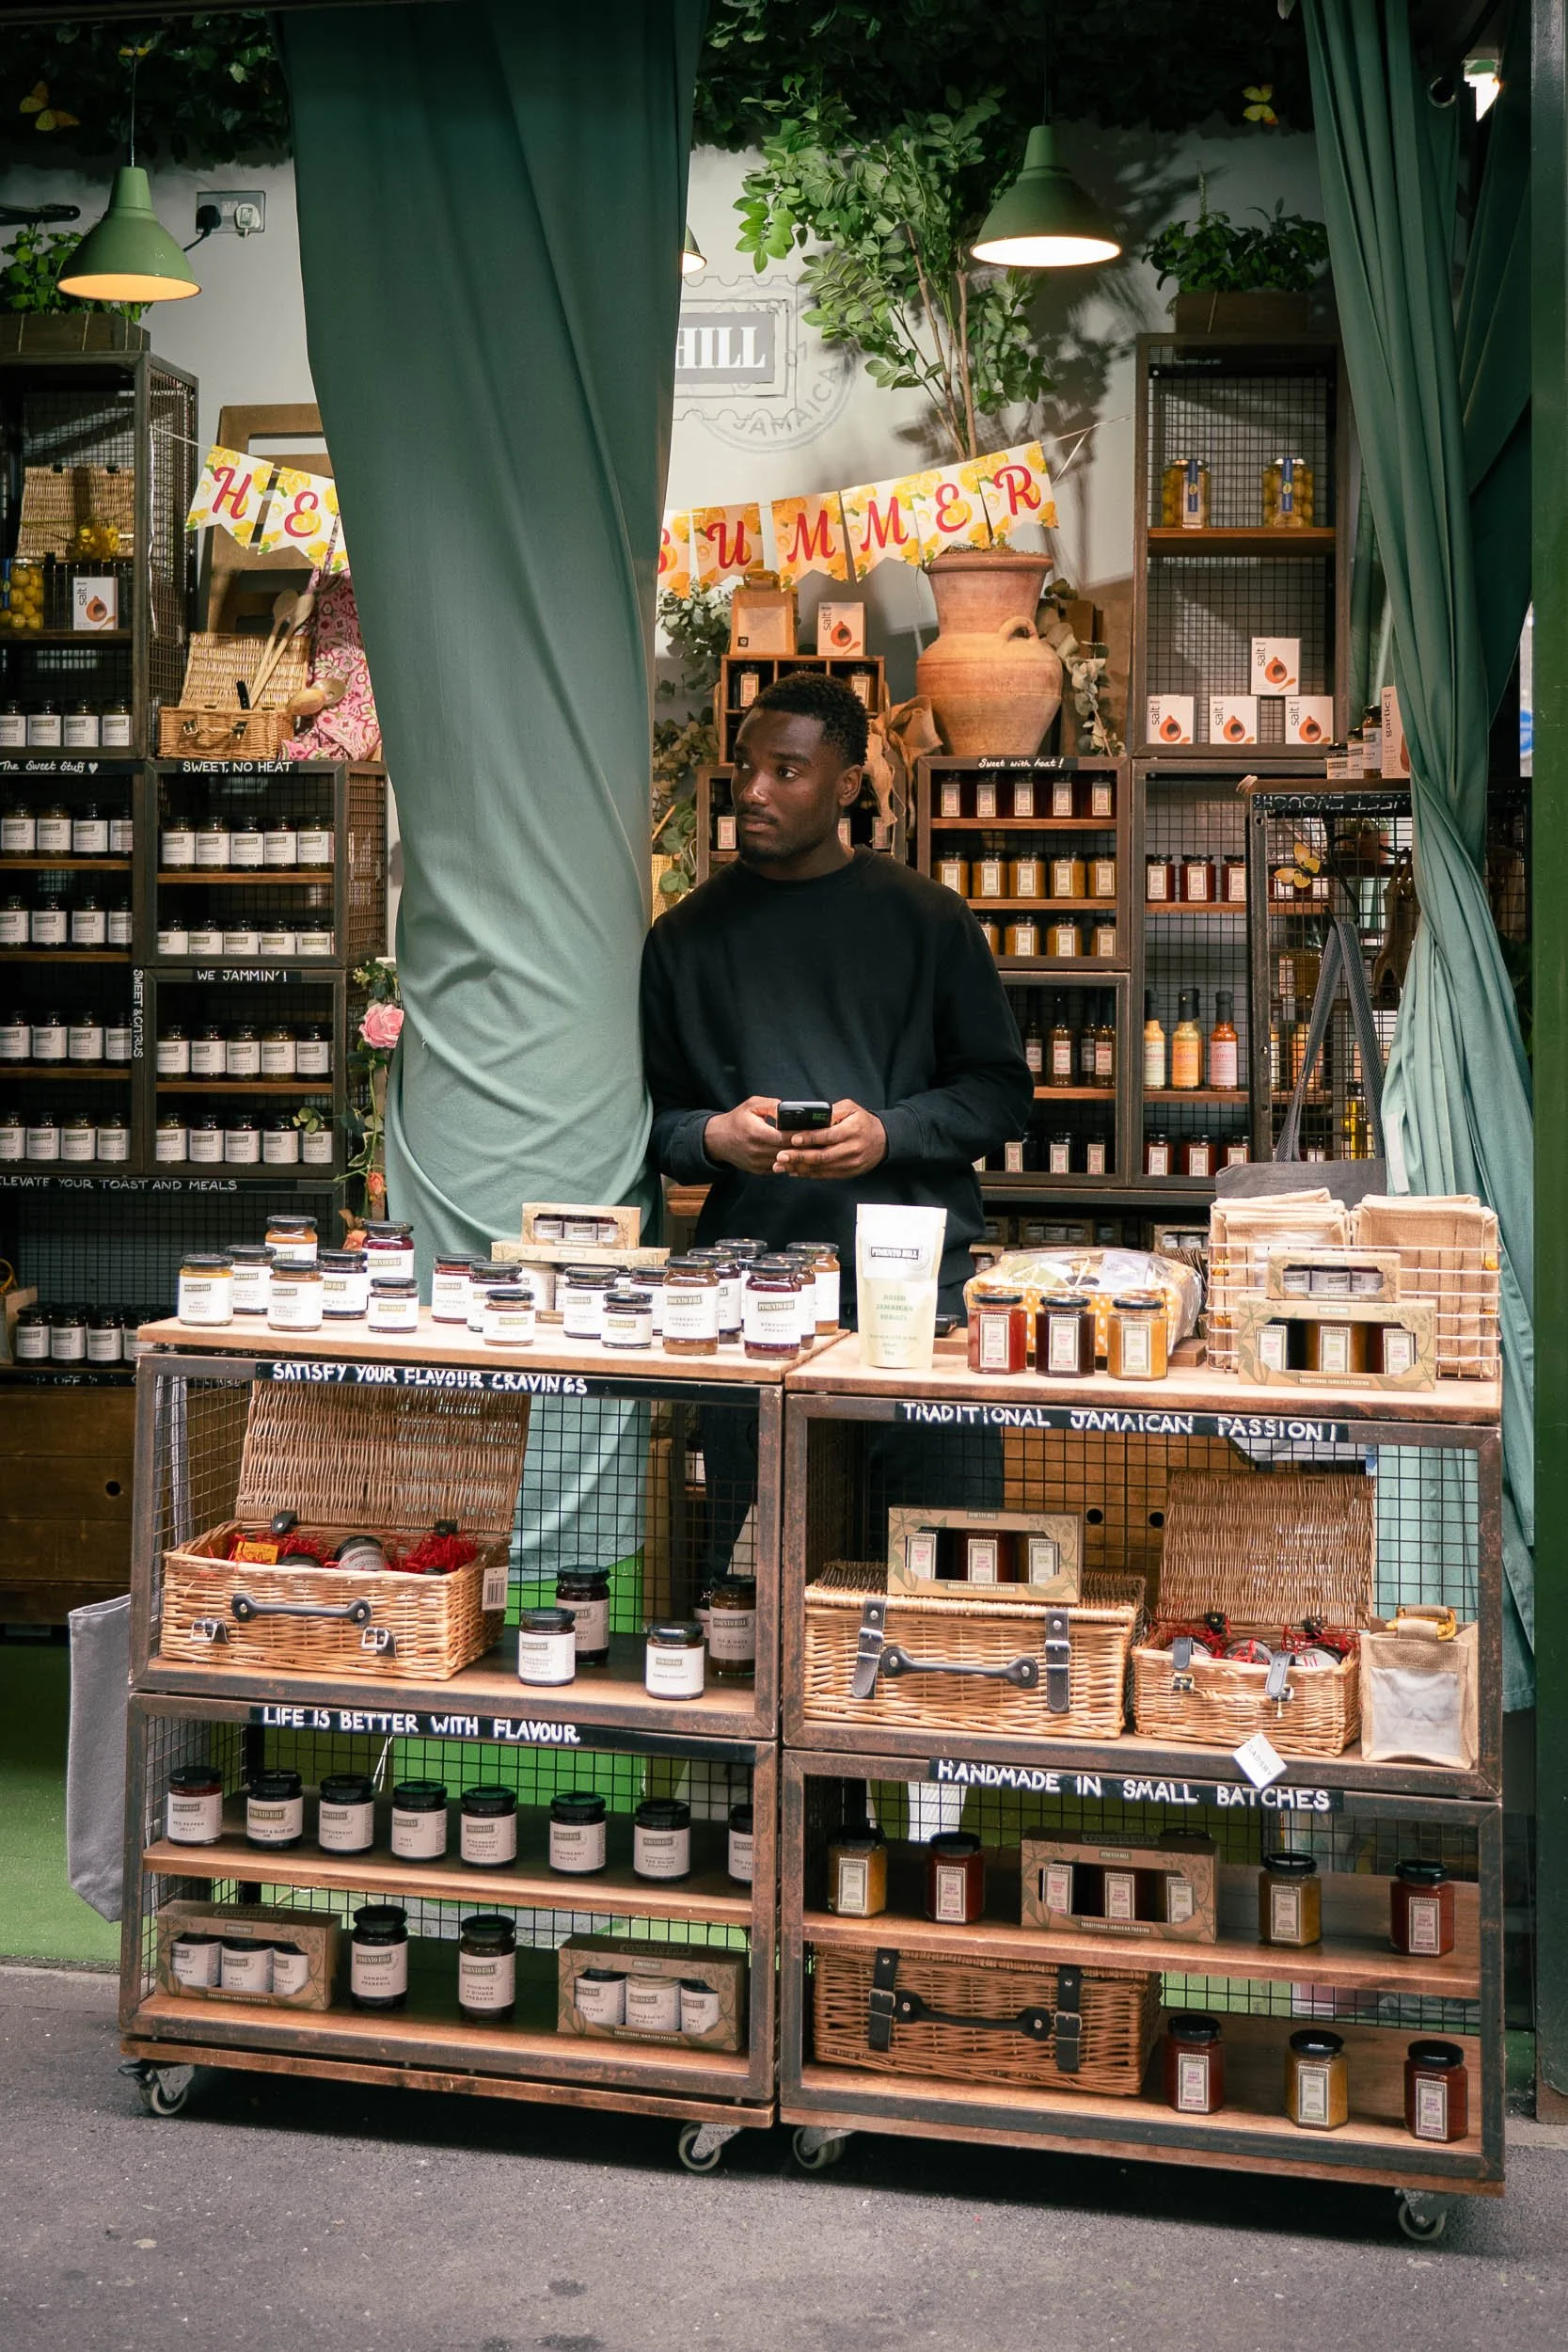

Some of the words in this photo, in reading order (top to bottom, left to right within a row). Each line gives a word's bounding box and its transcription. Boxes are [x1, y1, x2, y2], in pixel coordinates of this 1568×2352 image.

[675, 327, 766, 368] HILL
[732, 364, 840, 436] JAMAICA
[78, 586, 87, 606] salt
[1257, 646, 1266, 666] salt
[1291, 707, 1300, 725] salt
[25, 760, 56, 771] Sweet
[59, 760, 86, 775] Stuff
[232, 761, 254, 773] NO
[257, 760, 294, 773] HEAT
[978, 757, 1006, 768] Sweet
[1009, 758, 1031, 768] with
[133, 968, 144, 1008] SWEET
[197, 970, 217, 981] WE
[133, 1016, 144, 1058] CITRUS
[57, 1177, 94, 1190] YOUR
[99, 1178, 149, 1190] TOAST
[152, 1179, 182, 1191] AND
[189, 1179, 237, 1192] MEALS
[272, 1361, 348, 1382] SATISFY
[356, 1365, 398, 1386] YOUR
[404, 1368, 484, 1391] FLAVOUR
[491, 1372, 589, 1396] CRAVINGS
[902, 1402, 1051, 1428] TRADITIONAL
[1069, 1410, 1194, 1436] JAMAICAN
[262, 1706, 306, 1728] LIFE
[312, 1708, 331, 1729] IS
[340, 1710, 420, 1735] BETTER
[430, 1715, 480, 1738] WITH
[493, 1718, 581, 1745] FLAVOUR
[937, 1758, 1061, 1795] HANDMADE
[1076, 1775, 1102, 1798] IN
[1122, 1780, 1198, 1804] SMALL
[1216, 1785, 1331, 1812] BATCHES
